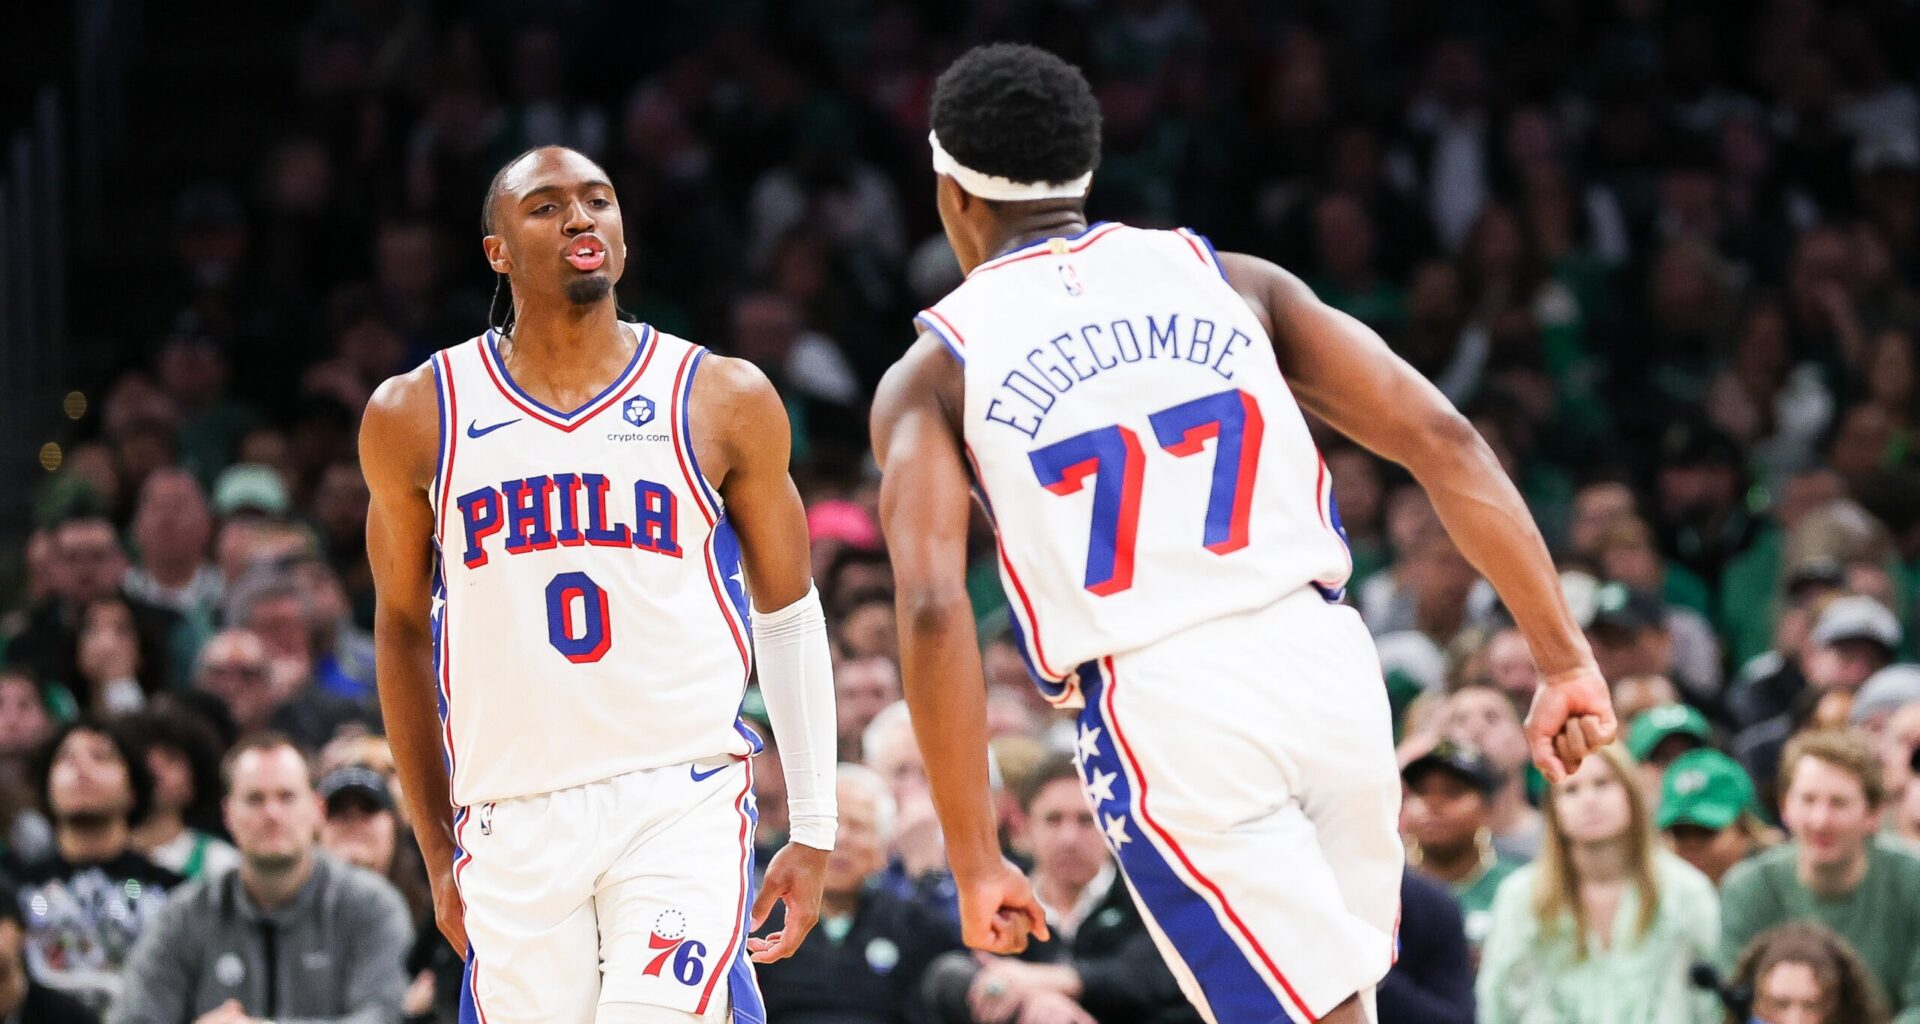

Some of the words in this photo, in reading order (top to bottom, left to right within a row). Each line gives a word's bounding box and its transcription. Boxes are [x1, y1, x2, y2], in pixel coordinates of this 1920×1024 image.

[985, 313, 1252, 440] EDGECOMBE
[606, 433, 670, 442] crypto.com
[456, 472, 683, 570] PHILA
[1027, 388, 1265, 598] 77
[545, 571, 612, 664] 0
[642, 930, 707, 986] 76
